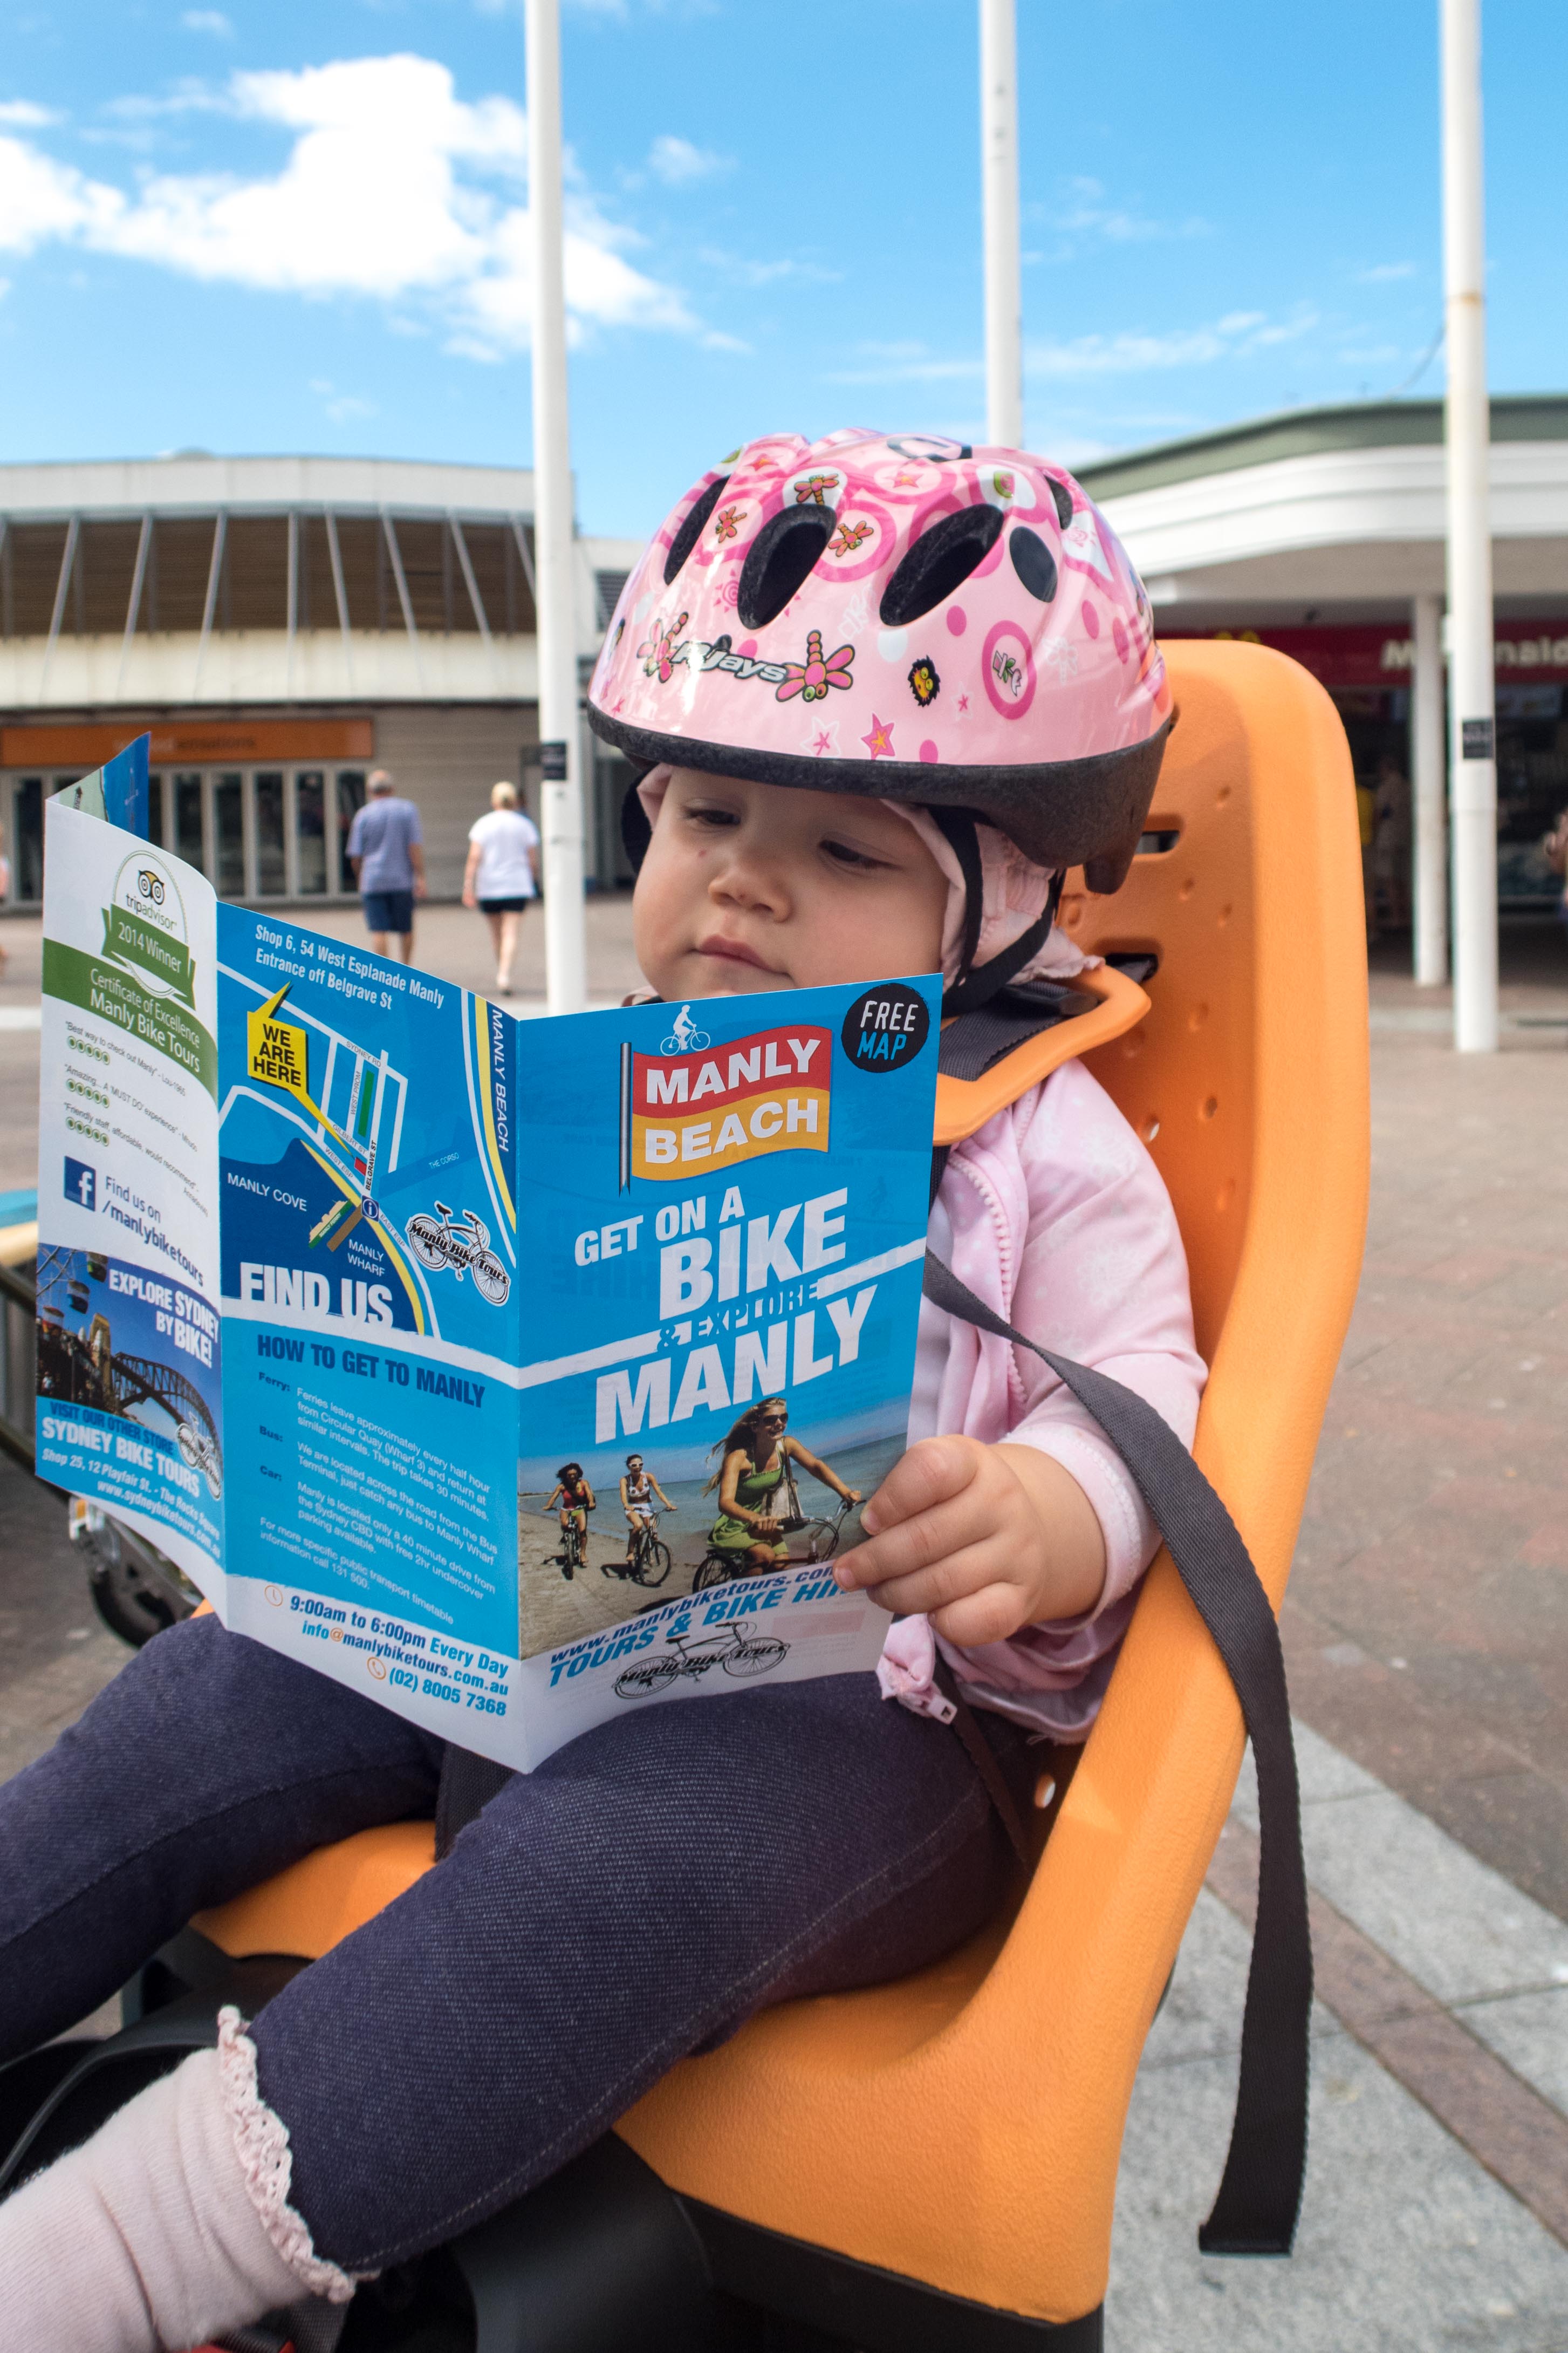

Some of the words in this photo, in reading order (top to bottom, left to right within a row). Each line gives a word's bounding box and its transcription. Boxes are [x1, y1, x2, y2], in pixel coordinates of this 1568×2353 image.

[125, 894, 174, 929] tripadvisor
[118, 922, 144, 949] 2014
[146, 936, 181, 972] Winner
[255, 925, 282, 948] Shop
[286, 935, 295, 953] 6,
[300, 940, 313, 956] 54
[318, 945, 345, 967] West
[348, 957, 406, 990] Esplanade
[409, 979, 443, 1008] Manly
[256, 948, 305, 977] Entrance
[309, 969, 325, 984] off
[327, 973, 376, 1002] Belgrave
[380, 992, 392, 1009] St
[90, 989, 136, 1029] Manly
[138, 1013, 165, 1046] Bike
[167, 1032, 200, 1072] Tours
[91, 969, 141, 1007] Certificate
[143, 999, 153, 1014] of
[155, 1003, 200, 1046] Excellence
[263, 1024, 291, 1047] WE
[860, 1000, 919, 1032] FREE
[254, 1056, 301, 1087] HERE
[259, 1041, 295, 1067] ARE
[346, 1041, 371, 1060] SYDNEY
[372, 1057, 381, 1067] RD
[492, 1009, 506, 1080] MANLY
[647, 1039, 821, 1105] MANLY
[857, 1031, 907, 1060] MAP
[350, 1095, 358, 1115] WEST
[353, 1071, 361, 1095] PROM
[332, 1124, 359, 1147] GILBERT
[358, 1144, 366, 1155] ST
[496, 1082, 509, 1153] BEACH
[645, 1099, 818, 1164] BEACH
[325, 1147, 342, 1165] WEST
[341, 1164, 353, 1178] ESP
[365, 1150, 375, 1191] BELGRAVE
[371, 1140, 377, 1150] ST
[428, 1159, 441, 1169] THE
[440, 1152, 459, 1164] CORSO
[106, 1176, 129, 1202] Find
[133, 1195, 145, 1211] us
[147, 1205, 160, 1222] on
[228, 1172, 270, 1197] MANLY
[273, 1189, 307, 1212] COVE
[102, 1201, 202, 1285] /manlybiketours
[349, 1239, 384, 1262] MANLY
[380, 1214, 394, 1232] EAST
[393, 1231, 405, 1247] ESP
[408, 1222, 449, 1251] Manly
[449, 1241, 476, 1264] Bike
[476, 1257, 509, 1286] Tours
[574, 1215, 644, 1267] GET
[655, 1196, 707, 1242] ON
[718, 1185, 745, 1224] A
[660, 1187, 848, 1321] BIKE
[347, 1252, 386, 1277] WHARF
[109, 1270, 172, 1310] EXPLORE
[175, 1291, 219, 1341] SYDNEY
[241, 1261, 330, 1317] FIND
[341, 1278, 394, 1328] US
[156, 1311, 173, 1335] BY
[174, 1319, 211, 1367] BIKE!
[595, 1284, 878, 1445] MANLY
[656, 1324, 682, 1350] &
[258, 1335, 304, 1361] HOW
[311, 1343, 335, 1368] TO
[342, 1351, 379, 1377] GET
[385, 1360, 409, 1386] TO
[416, 1368, 484, 1407] MANLY
[258, 1372, 290, 1392] Ferry:
[50, 1401, 80, 1421] VISIT
[83, 1407, 105, 1429] OUR
[108, 1414, 141, 1441] OTHER
[143, 1429, 174, 1456] STORE
[259, 1425, 283, 1442] Bus:
[297, 1387, 327, 1408] Ferries
[330, 1402, 354, 1420] leave
[357, 1417, 420, 1455] approximately
[423, 1451, 447, 1470] every
[450, 1463, 467, 1479] half
[469, 1474, 490, 1492] hour
[297, 1401, 318, 1417] from
[320, 1412, 355, 1434] Circular
[358, 1429, 382, 1450] Quay
[385, 1443, 414, 1464] (Wharf
[417, 1459, 425, 1472] 3)
[428, 1467, 445, 1481] and
[448, 1478, 474, 1498] return
[477, 1495, 485, 1505] at
[42, 1417, 112, 1452] SYDNEY
[116, 1437, 153, 1470] BIKE
[156, 1453, 201, 1497] TOURS
[42, 1448, 67, 1465] Shop
[69, 1455, 85, 1469] 25,
[88, 1461, 100, 1473] 12
[99, 1463, 137, 1485] Playfair
[139, 1478, 150, 1492] St.
[161, 1487, 175, 1504] The
[259, 1464, 282, 1482] Car:
[298, 1417, 327, 1434] similar
[329, 1430, 369, 1455] intervals.
[372, 1449, 389, 1465] The
[392, 1461, 407, 1475] trip
[409, 1470, 434, 1489] takes
[436, 1484, 448, 1497] 30
[450, 1494, 488, 1520] minutes.
[298, 1442, 312, 1455] We
[314, 1451, 328, 1463] are
[331, 1457, 365, 1480] located
[367, 1477, 397, 1497] across
[399, 1492, 414, 1506] the
[416, 1502, 436, 1518] road
[439, 1513, 460, 1531] from
[462, 1527, 477, 1541] the
[480, 1536, 497, 1554] Bus
[298, 1455, 338, 1482] Terminal,
[340, 1475, 357, 1490] just
[359, 1486, 385, 1504] catch
[387, 1501, 403, 1515] any
[406, 1508, 422, 1524] bus
[425, 1519, 434, 1530] to
[437, 1525, 463, 1549] Manly
[467, 1542, 494, 1565] Wharf
[291, 1596, 346, 1622] 9:00am
[351, 1612, 366, 1628] to
[371, 1618, 425, 1648] 6:00pm
[430, 1638, 473, 1667] Every
[477, 1653, 508, 1678] Day
[302, 1622, 508, 1694] info@manlybiketours.com.au
[550, 1626, 658, 1686] TOURS
[666, 1613, 691, 1639] &
[702, 1588, 786, 1625] BIKE
[792, 1577, 847, 1602] HI
[389, 1668, 417, 1692] (02)
[422, 1679, 460, 1703] 8005
[467, 1693, 506, 1715] 7368
[619, 1661, 680, 1683] Manly
[682, 1652, 730, 1668] Bike
[731, 1645, 788, 1660] Tours
